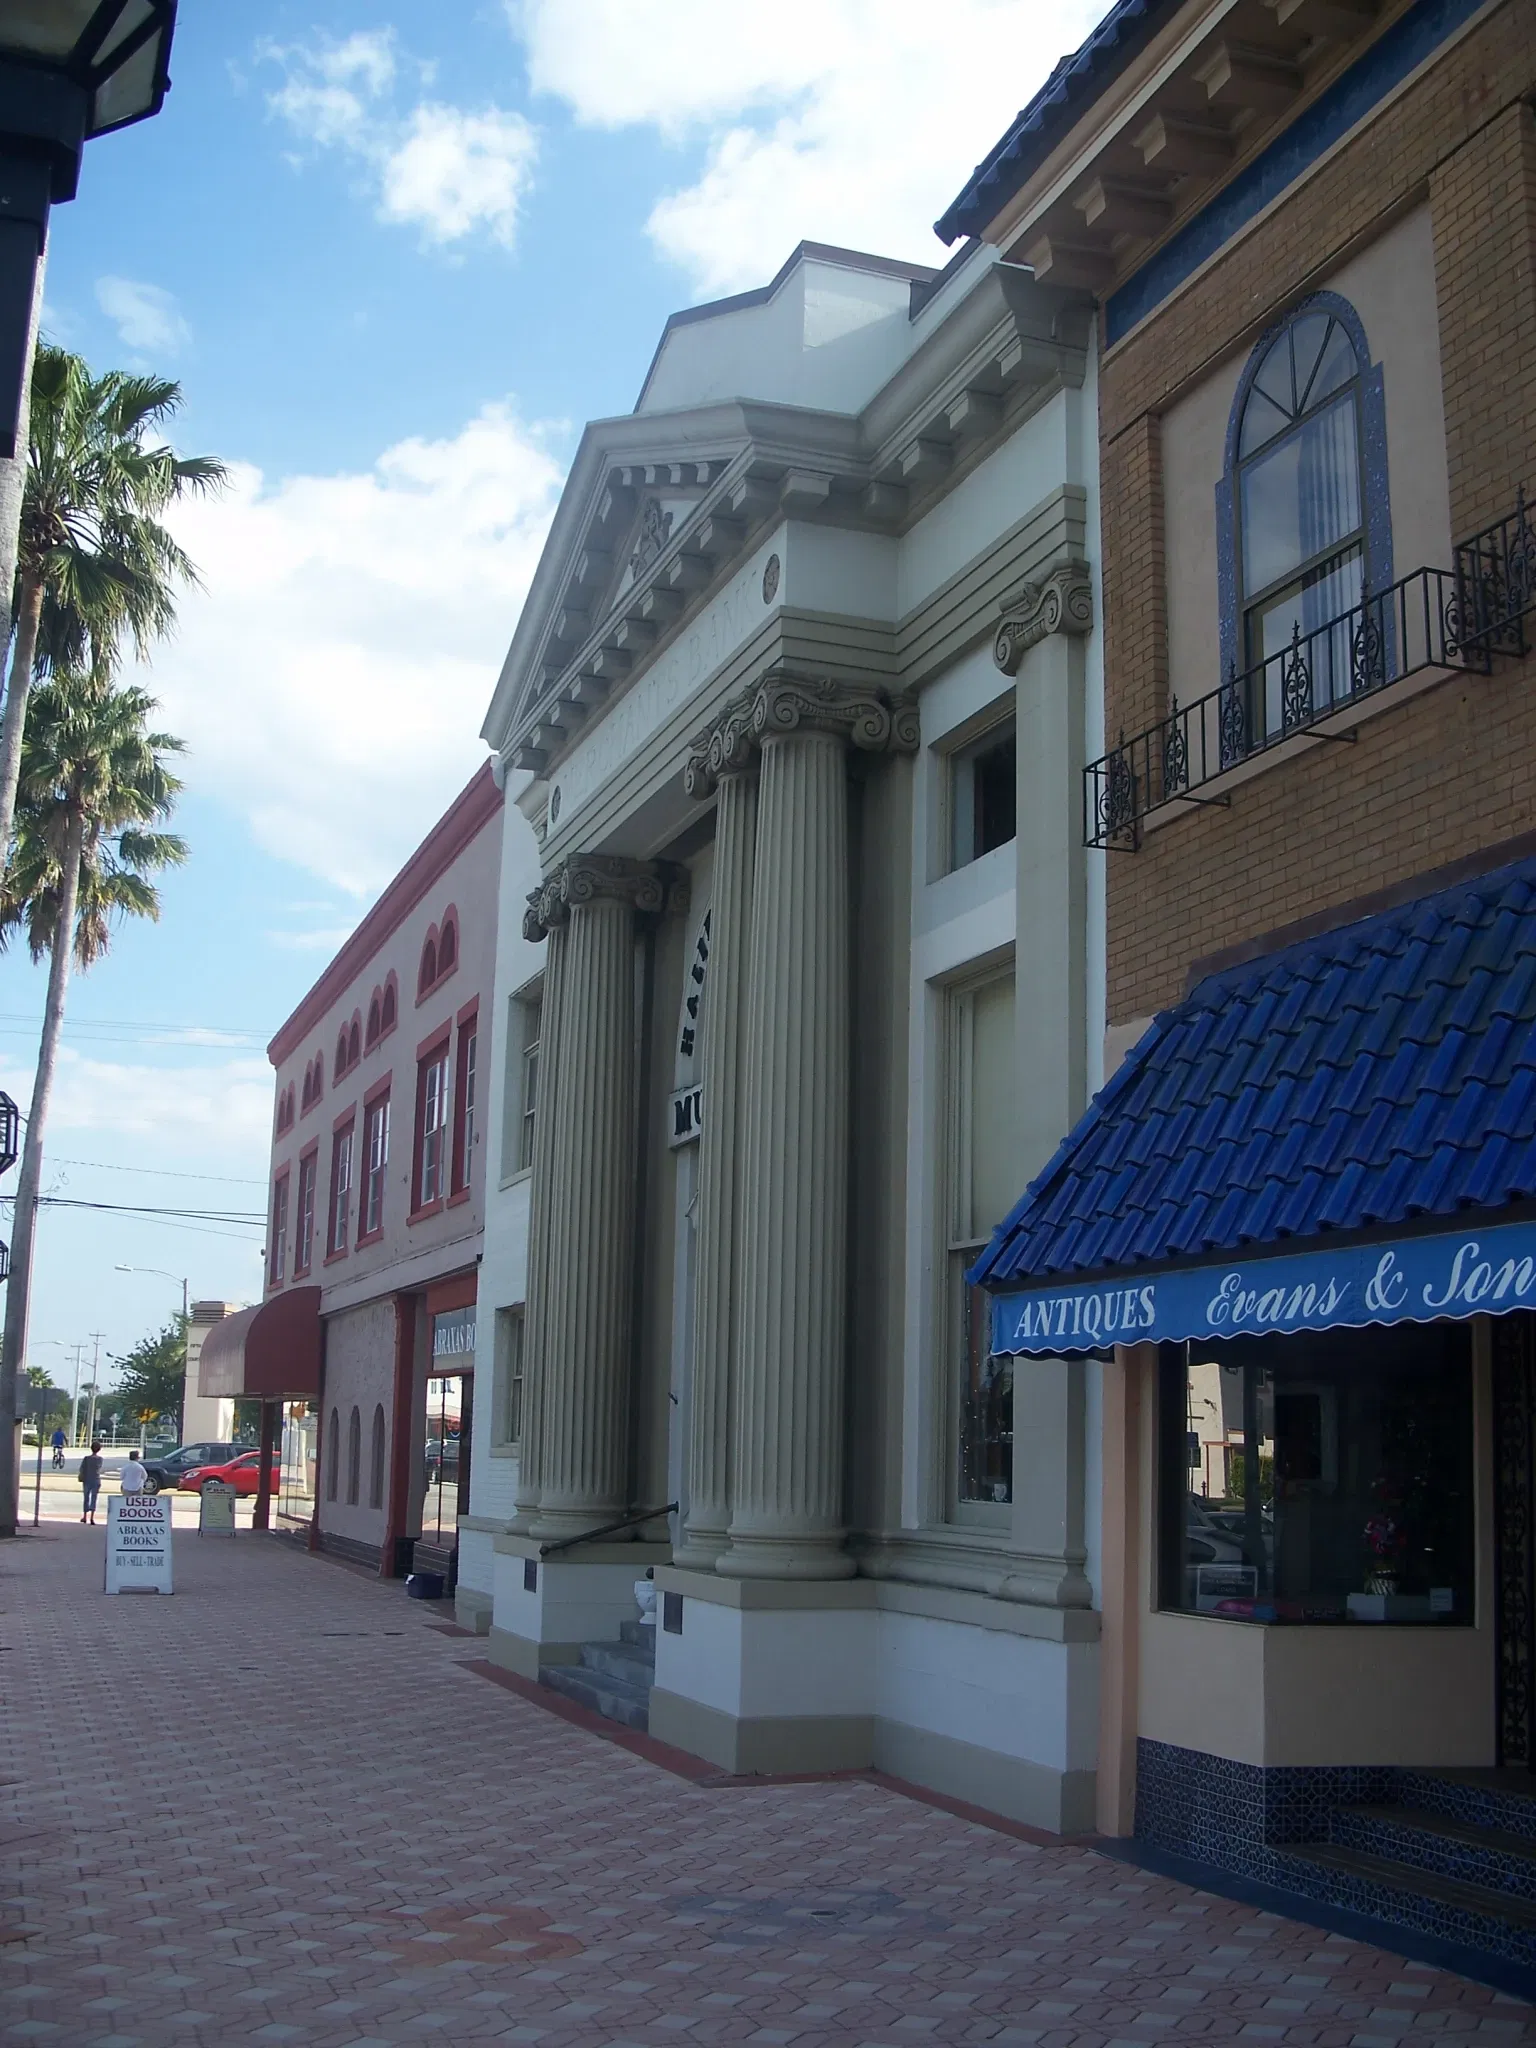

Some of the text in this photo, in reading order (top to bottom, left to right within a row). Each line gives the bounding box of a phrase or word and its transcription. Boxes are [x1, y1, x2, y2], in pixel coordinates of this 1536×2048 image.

[688, 569, 758, 686] BANK
[1205, 1272, 1351, 1325] Evans
[1364, 1250, 1409, 1311] &
[1013, 1285, 1156, 1340] ANTIQUES
[432, 1325, 464, 1356] ABRAXAS
[126, 1497, 157, 1506] USED
[119, 1508, 163, 1518] BOOKS
[117, 1526, 165, 1535] ABRAXAS
[123, 1537, 158, 1545] BOOKS
